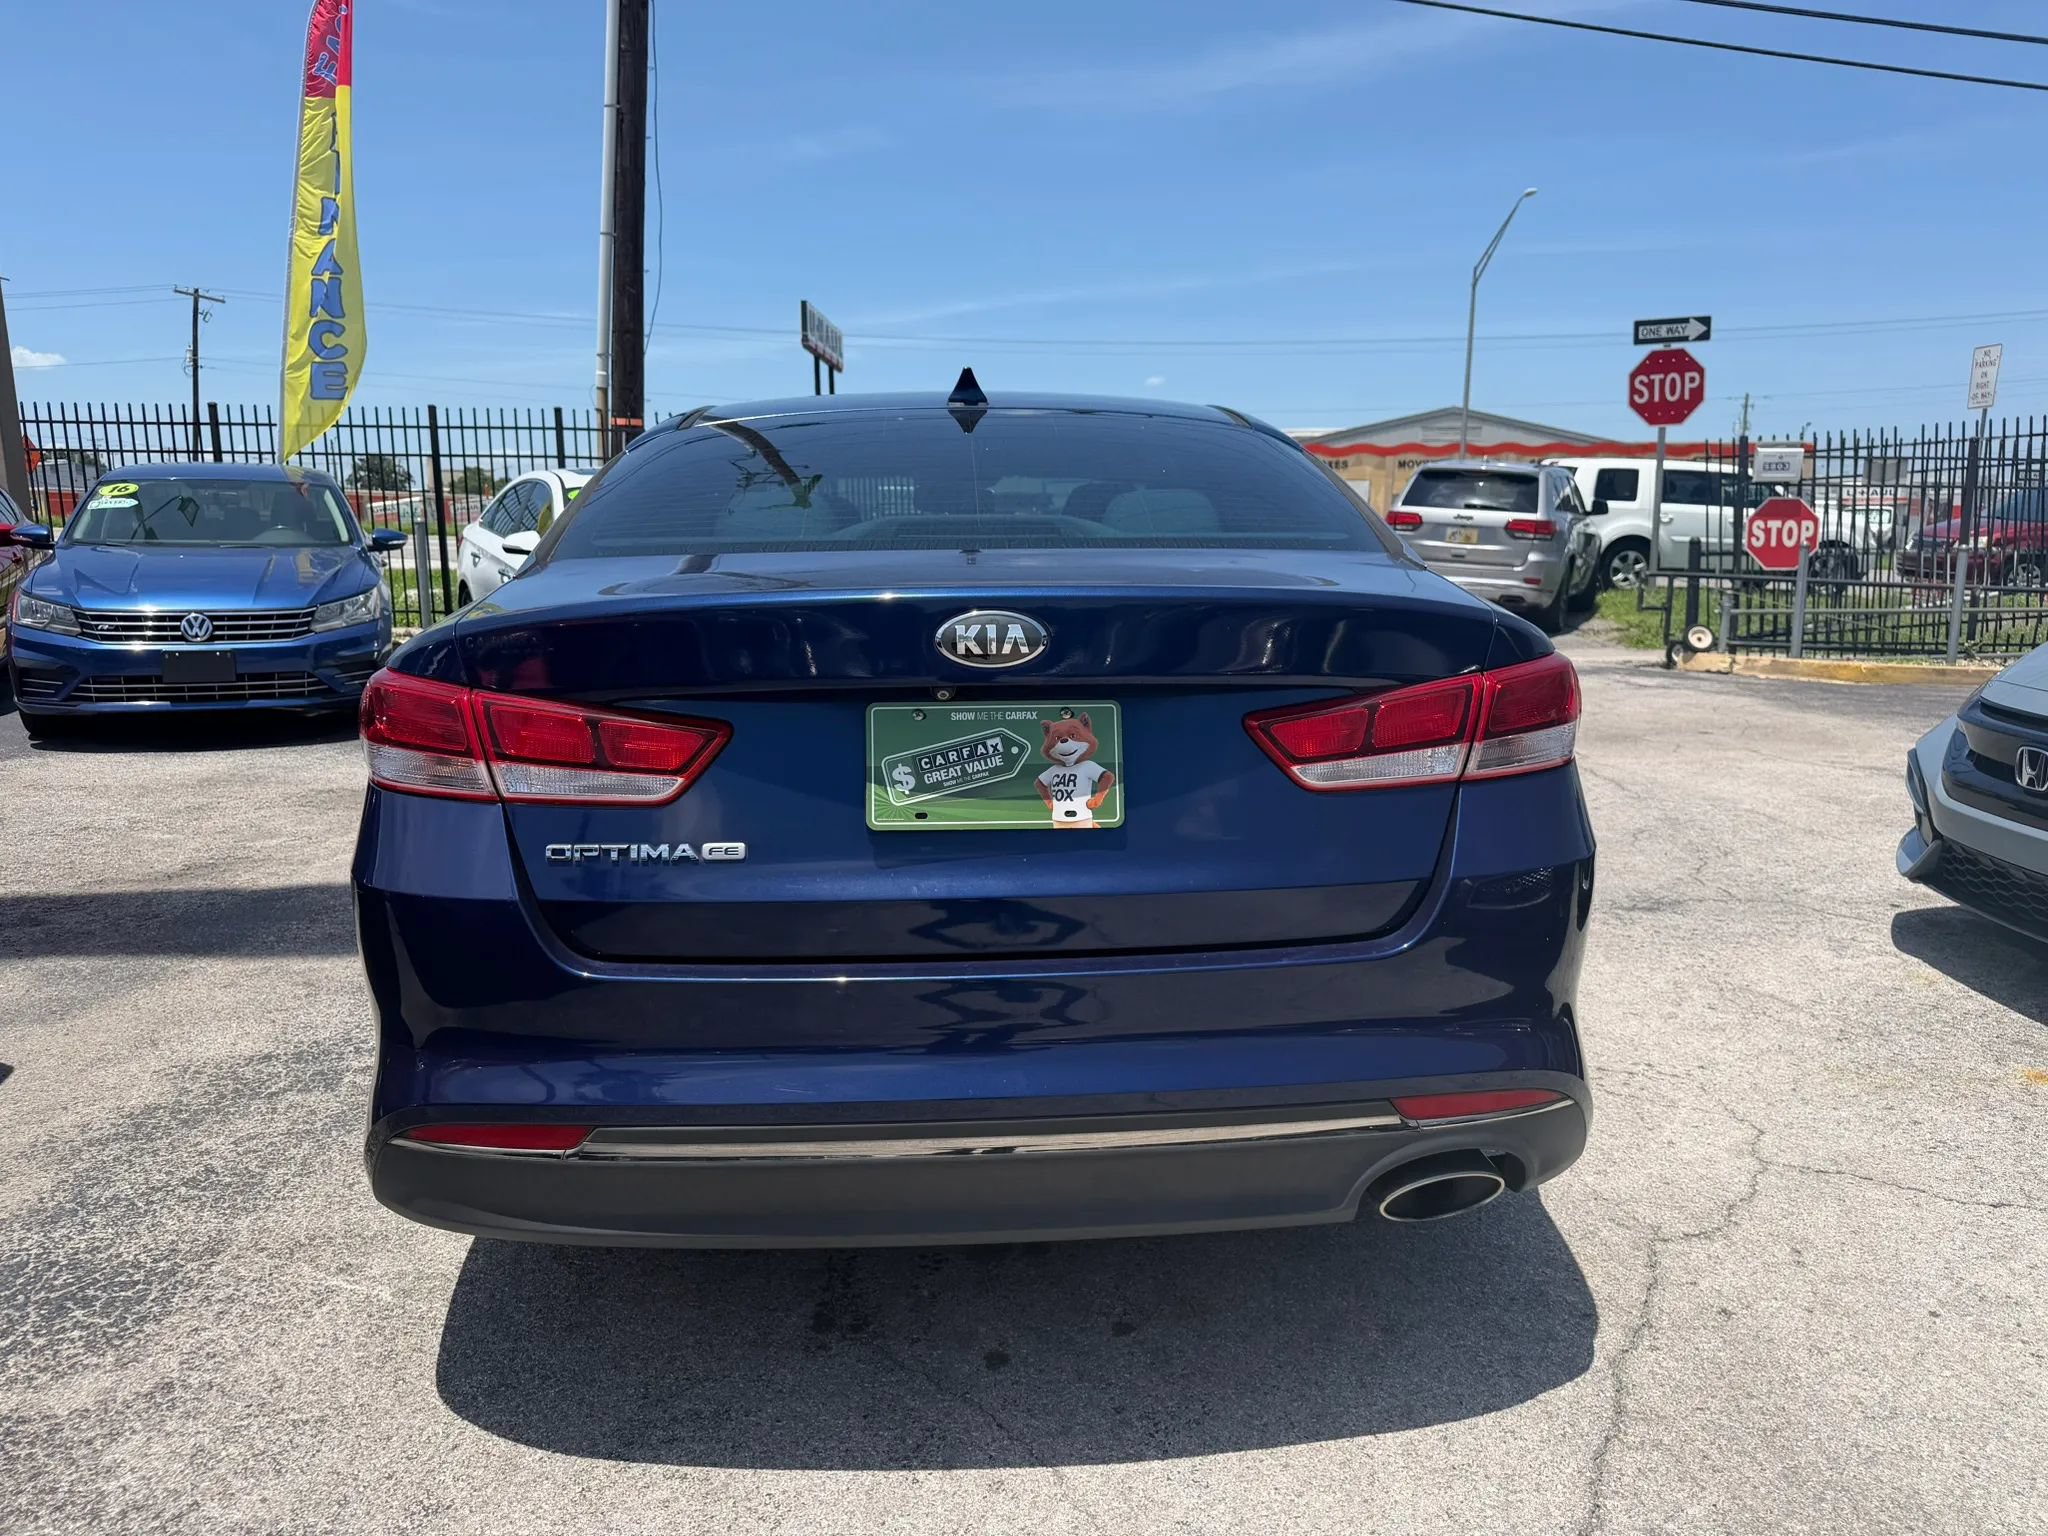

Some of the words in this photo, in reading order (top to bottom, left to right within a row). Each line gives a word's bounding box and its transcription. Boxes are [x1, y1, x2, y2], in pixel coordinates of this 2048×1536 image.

[1641, 326, 1662, 337] ONE
[1666, 324, 1687, 335] WAY
[1633, 371, 1701, 404] STOP
[1751, 519, 1816, 548] STOP
[955, 623, 1031, 655] KIA
[950, 711, 976, 720] SHOW
[977, 711, 989, 720] ME
[990, 711, 1004, 720] THE
[1005, 710, 1038, 720] CARFAX
[919, 740, 1002, 771] CARFAX
[924, 765, 963, 784] GREAT
[965, 755, 1004, 774] VALUE
[1052, 773, 1078, 788] CAR
[546, 843, 700, 862] OPTIMA
[706, 845, 742, 858] FE
